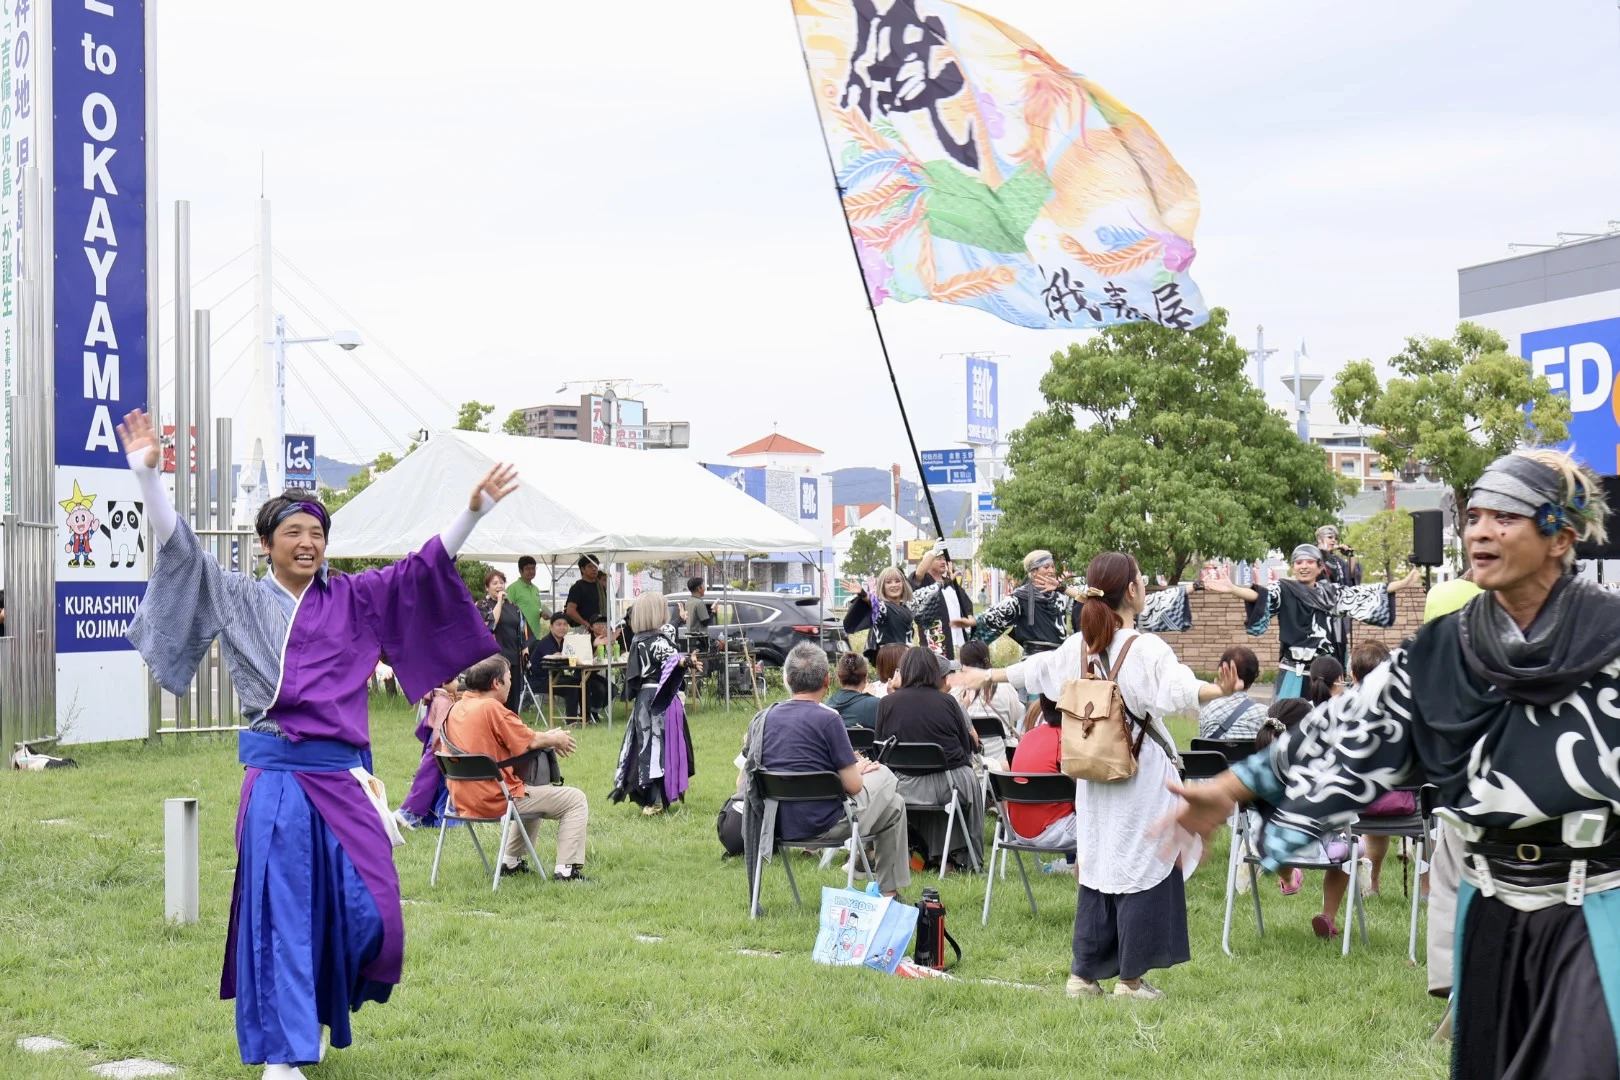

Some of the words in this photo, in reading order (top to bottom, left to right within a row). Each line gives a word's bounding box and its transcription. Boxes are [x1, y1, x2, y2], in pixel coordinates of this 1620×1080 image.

[81, 32, 117, 75] to
[82, 92, 120, 453] OKAYAMA
[972, 365, 994, 419] 靴
[286, 440, 312, 470] は
[65, 596, 138, 614] KURASHIKI
[76, 620, 128, 638] KOJIMA
